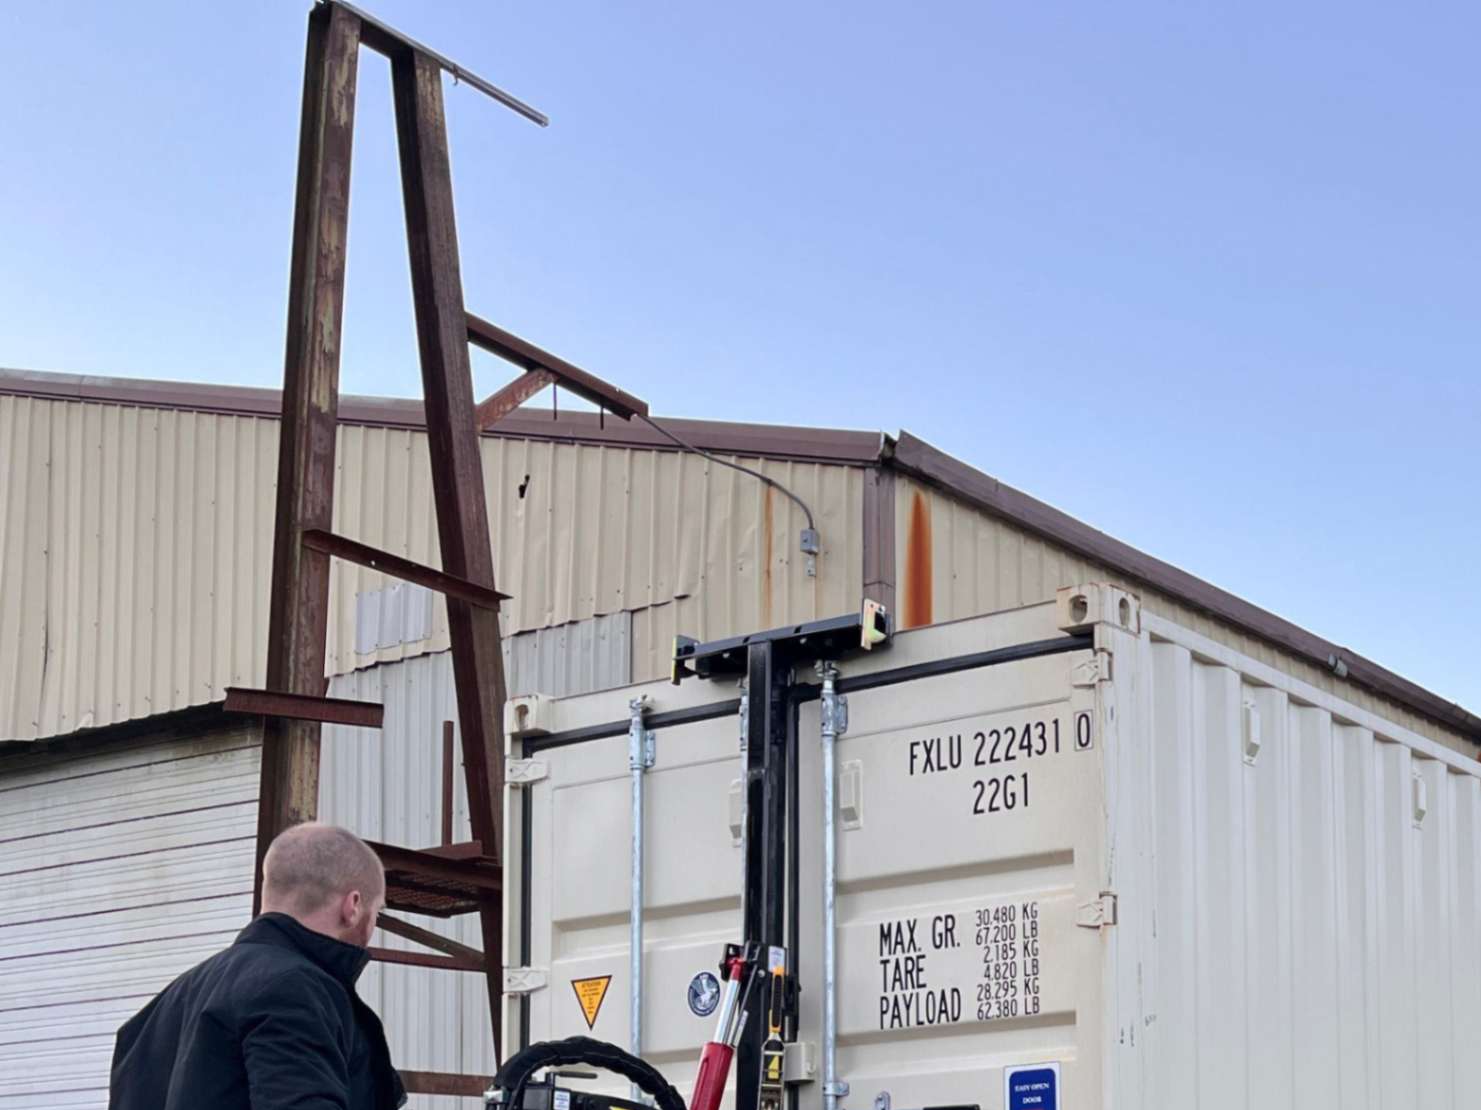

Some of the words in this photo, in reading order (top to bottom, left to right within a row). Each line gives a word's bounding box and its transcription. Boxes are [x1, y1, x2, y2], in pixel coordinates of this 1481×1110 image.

[909, 734, 962, 776] FXLU
[973, 718, 1060, 767] 222431
[1077, 713, 1091, 749] 0
[972, 772, 1029, 815] 22G1
[975, 904, 1016, 927] 30.480
[1022, 901, 1038, 921] KG
[879, 918, 922, 957] MAX.
[932, 914, 961, 950] GR.
[975, 923, 1016, 946] 67.200
[1022, 920, 1038, 939] LB
[1023, 939, 1039, 958] KG
[880, 954, 927, 993] TARE
[1023, 958, 1039, 977] LB
[1024, 977, 1040, 996] KG
[880, 987, 962, 1030] PAYLOAD
[1024, 996, 1040, 1016] LB
